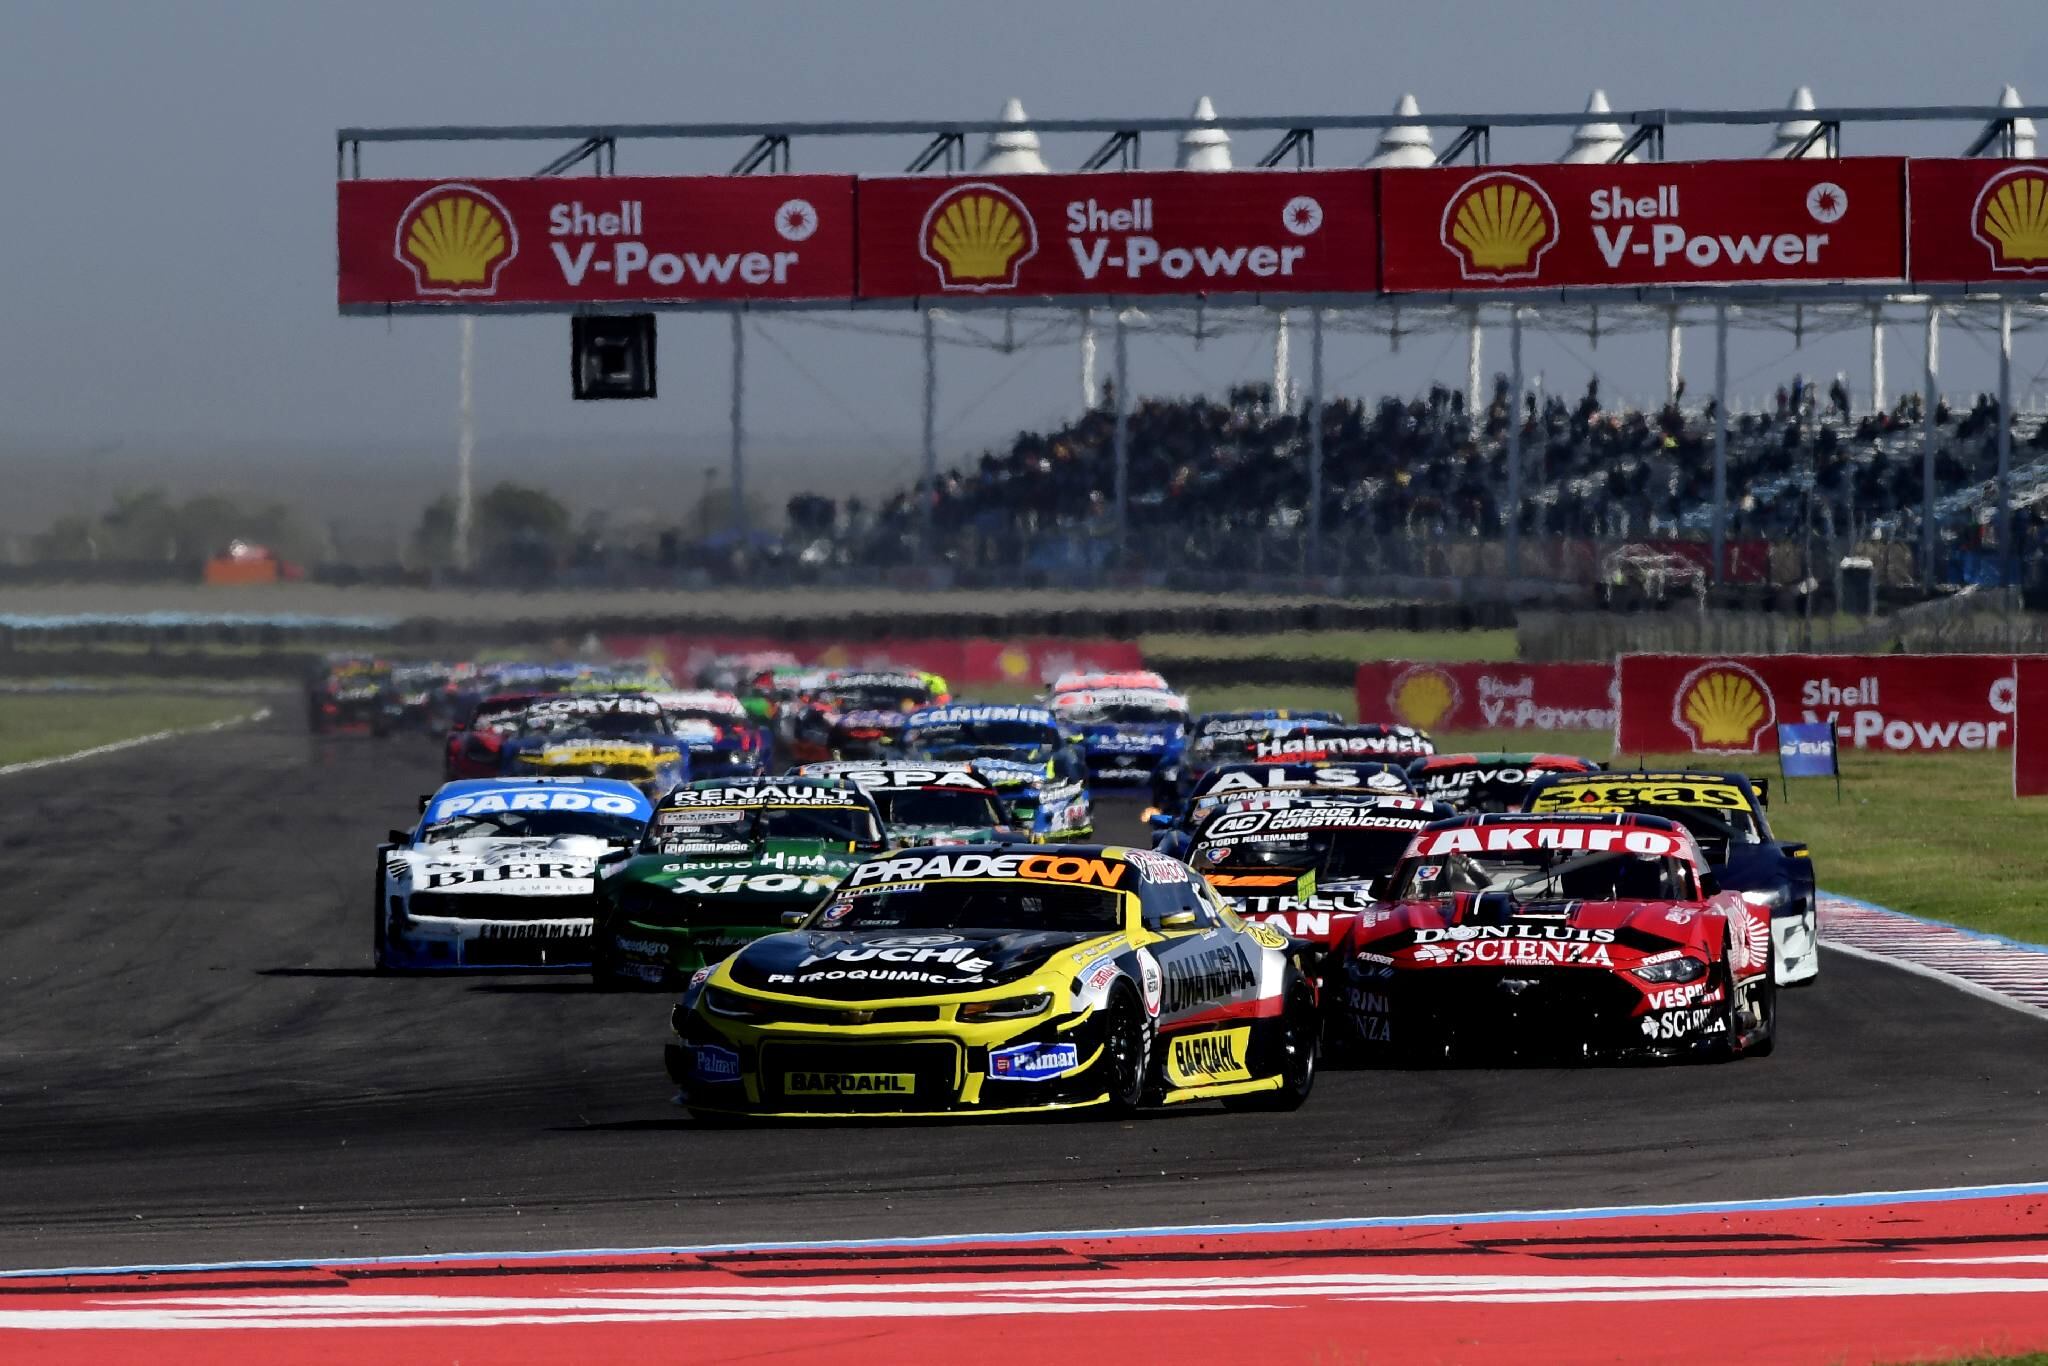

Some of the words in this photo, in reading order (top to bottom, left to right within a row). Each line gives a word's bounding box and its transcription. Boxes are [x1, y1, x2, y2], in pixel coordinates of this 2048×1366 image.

[1590, 184, 1679, 219] Shell
[549, 201, 643, 236] Shell
[1066, 198, 1153, 234] Shell
[1067, 236, 1306, 279] V-Power
[1592, 223, 1829, 268] V-Power
[550, 241, 799, 287] V-Power
[1802, 677, 1879, 707] Shell
[436, 793, 638, 820] PARDO
[674, 785, 855, 801] RENAULT
[674, 797, 854, 807] CONCESIONARIOS
[1218, 816, 1258, 832] AC
[1274, 807, 1357, 820] ACEROS
[1358, 807, 1372, 818] Y
[1209, 837, 1239, 848] TODO
[1241, 832, 1309, 844] RULEMANES
[662, 861, 753, 872] GRUPO
[850, 854, 1127, 887] PRADECON
[1514, 924, 1617, 944] LUIS
[1455, 940, 1616, 968] SCIENZA
[697, 1051, 739, 1075] Palmar
[1013, 1050, 1076, 1072] Palmar
[1174, 1033, 1244, 1082] BARDAHL
[790, 1073, 907, 1094] BARDAHL
